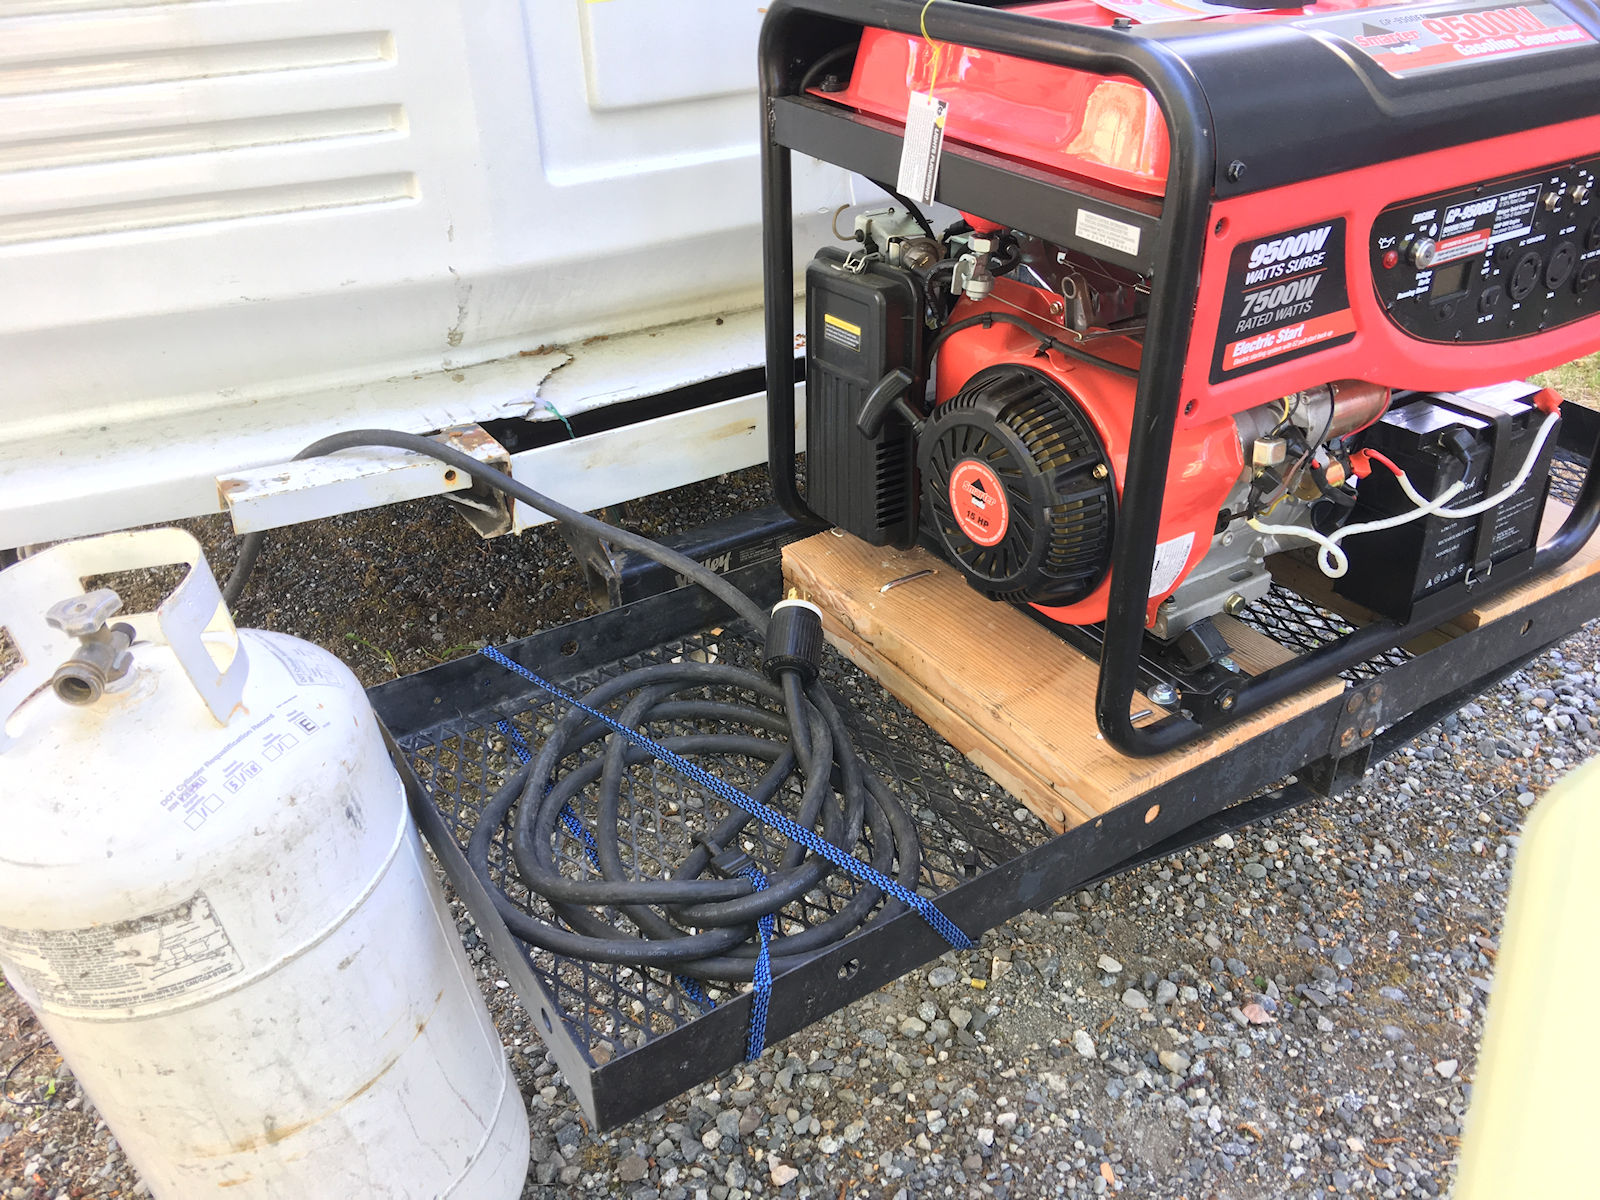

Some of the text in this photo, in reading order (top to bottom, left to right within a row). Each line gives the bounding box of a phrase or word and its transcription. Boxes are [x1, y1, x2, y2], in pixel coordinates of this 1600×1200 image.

[1353, 30, 1420, 48] Smarter
[1421, 6, 1547, 43] 9500W
[1453, 38, 1520, 56] Gasoline
[1247, 226, 1332, 269] 9500W
[1245, 252, 1326, 285] WATTS SURGE
[1240, 274, 1322, 317] 7500W
[1235, 300, 1314, 333] RATED WATTS
[1232, 323, 1305, 358] Electric Start
[961, 480, 997, 507] Smarter
[966, 510, 976, 520] 15
[977, 516, 989, 527] HP
[299, 718, 316, 732] E
[160, 790, 177, 806] DOT
[203, 729, 253, 768] Requalification
[250, 713, 275, 731] Record
